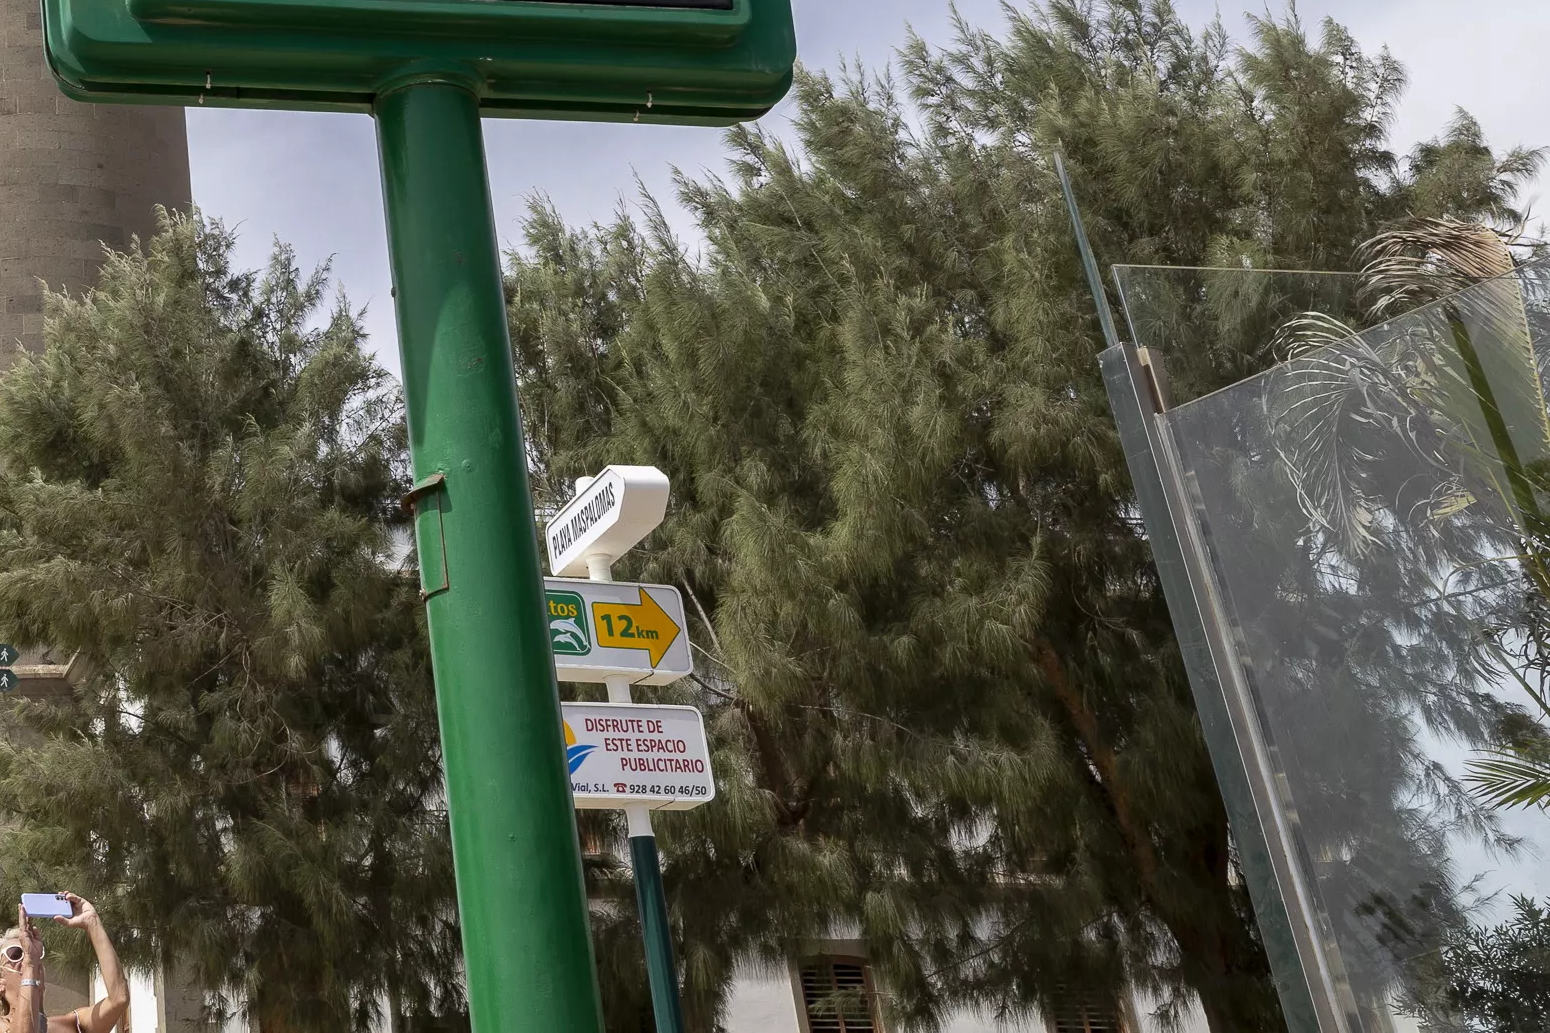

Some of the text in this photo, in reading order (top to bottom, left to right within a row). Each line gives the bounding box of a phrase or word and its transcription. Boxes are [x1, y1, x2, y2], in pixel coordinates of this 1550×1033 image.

[552, 481, 615, 559] PLAYA MASPALOMAS
[548, 600, 578, 616] tos
[585, 718, 663, 734] DISFRUTE DE
[604, 737, 686, 754] ESTE ESPACIO
[620, 757, 704, 773] PUBLICITARIO
[571, 782, 707, 797] Vial, S.L. 928 42 60 46/50
